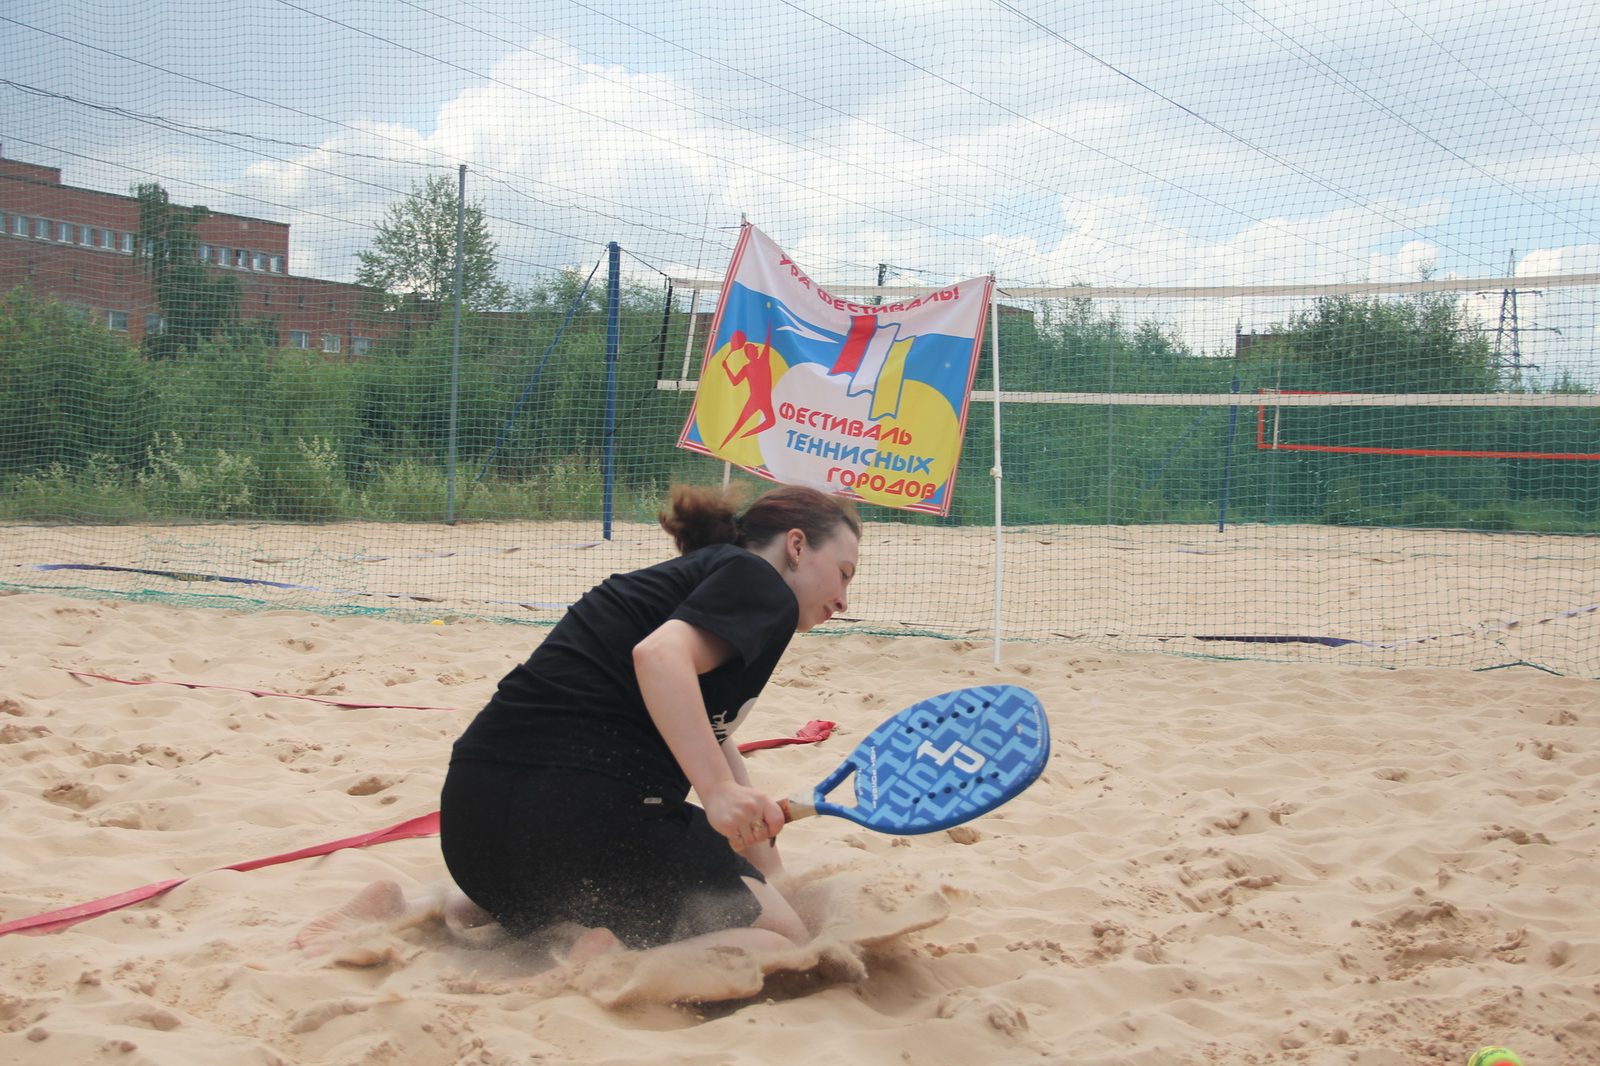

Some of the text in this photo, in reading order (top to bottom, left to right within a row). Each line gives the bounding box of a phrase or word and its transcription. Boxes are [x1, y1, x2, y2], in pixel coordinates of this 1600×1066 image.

[779, 254, 960, 315] УРА ФЕСТИВАЛЬ!
[779, 402, 913, 446] ФЕСТИВАЛЬ
[786, 429, 935, 475] ТЕННИСНЫХ
[826, 467, 937, 499] ГОРОДОВ
